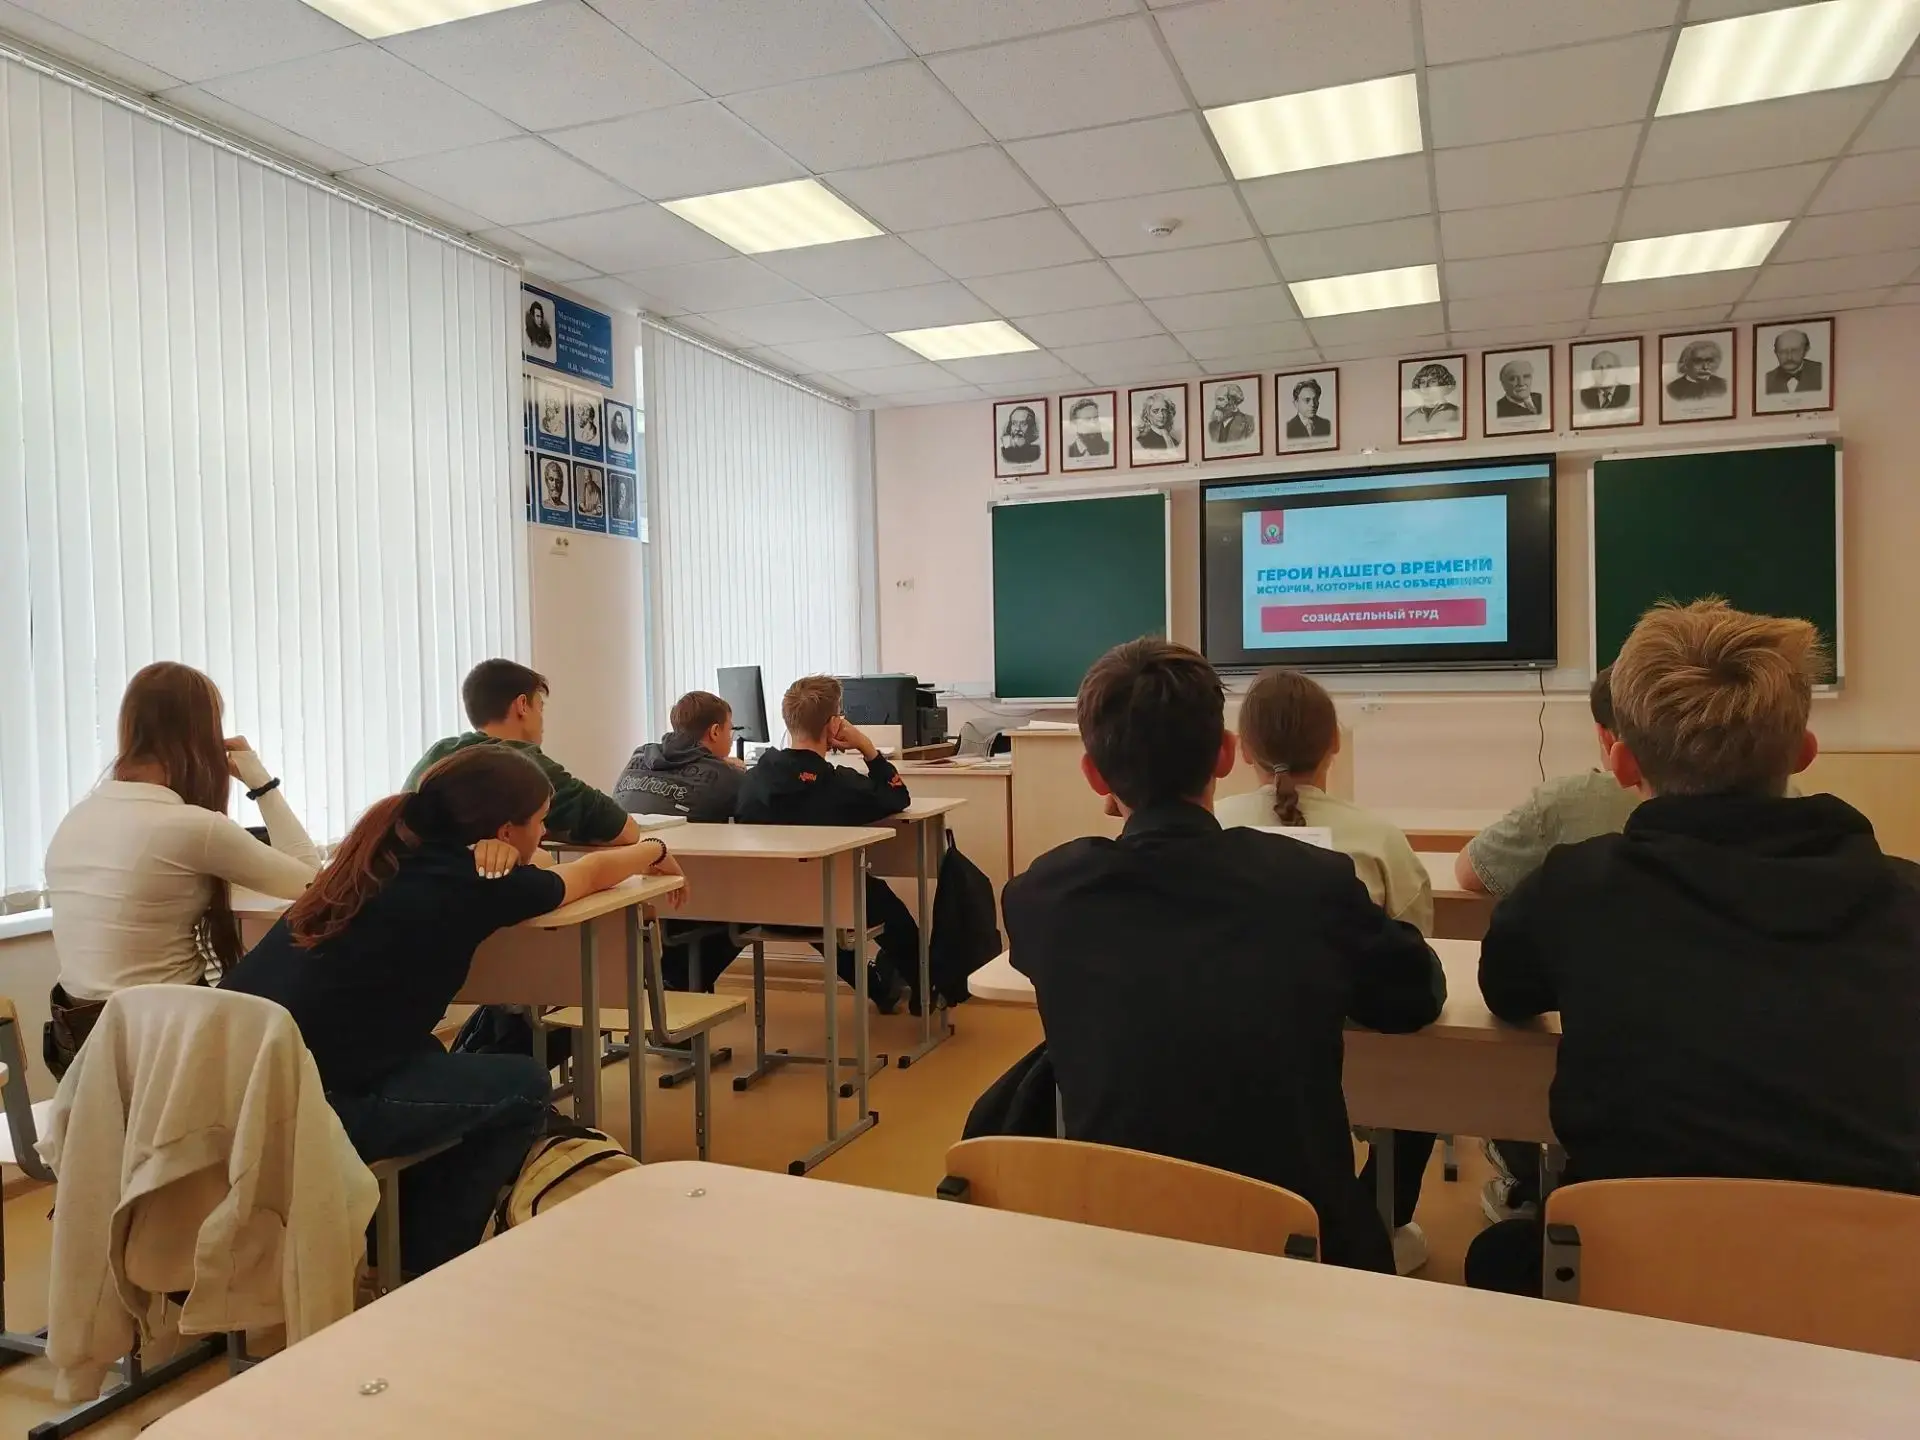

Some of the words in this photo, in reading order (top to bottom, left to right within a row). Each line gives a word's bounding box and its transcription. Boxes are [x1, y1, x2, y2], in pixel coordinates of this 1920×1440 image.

[1257, 567, 1313, 581] ГЕРОИ
[1318, 564, 1396, 579] НАШЕГО
[1401, 558, 1492, 575] ВРЕМЕНИ
[1257, 583, 1314, 594] ИСТОРИИ,
[1316, 581, 1373, 592] КОТОРЫЕ
[1376, 580, 1400, 589] НАС
[1302, 608, 1405, 622] СОЗИДАТЕЛЬНЫЙ
[1408, 609, 1439, 620] ТРУД
